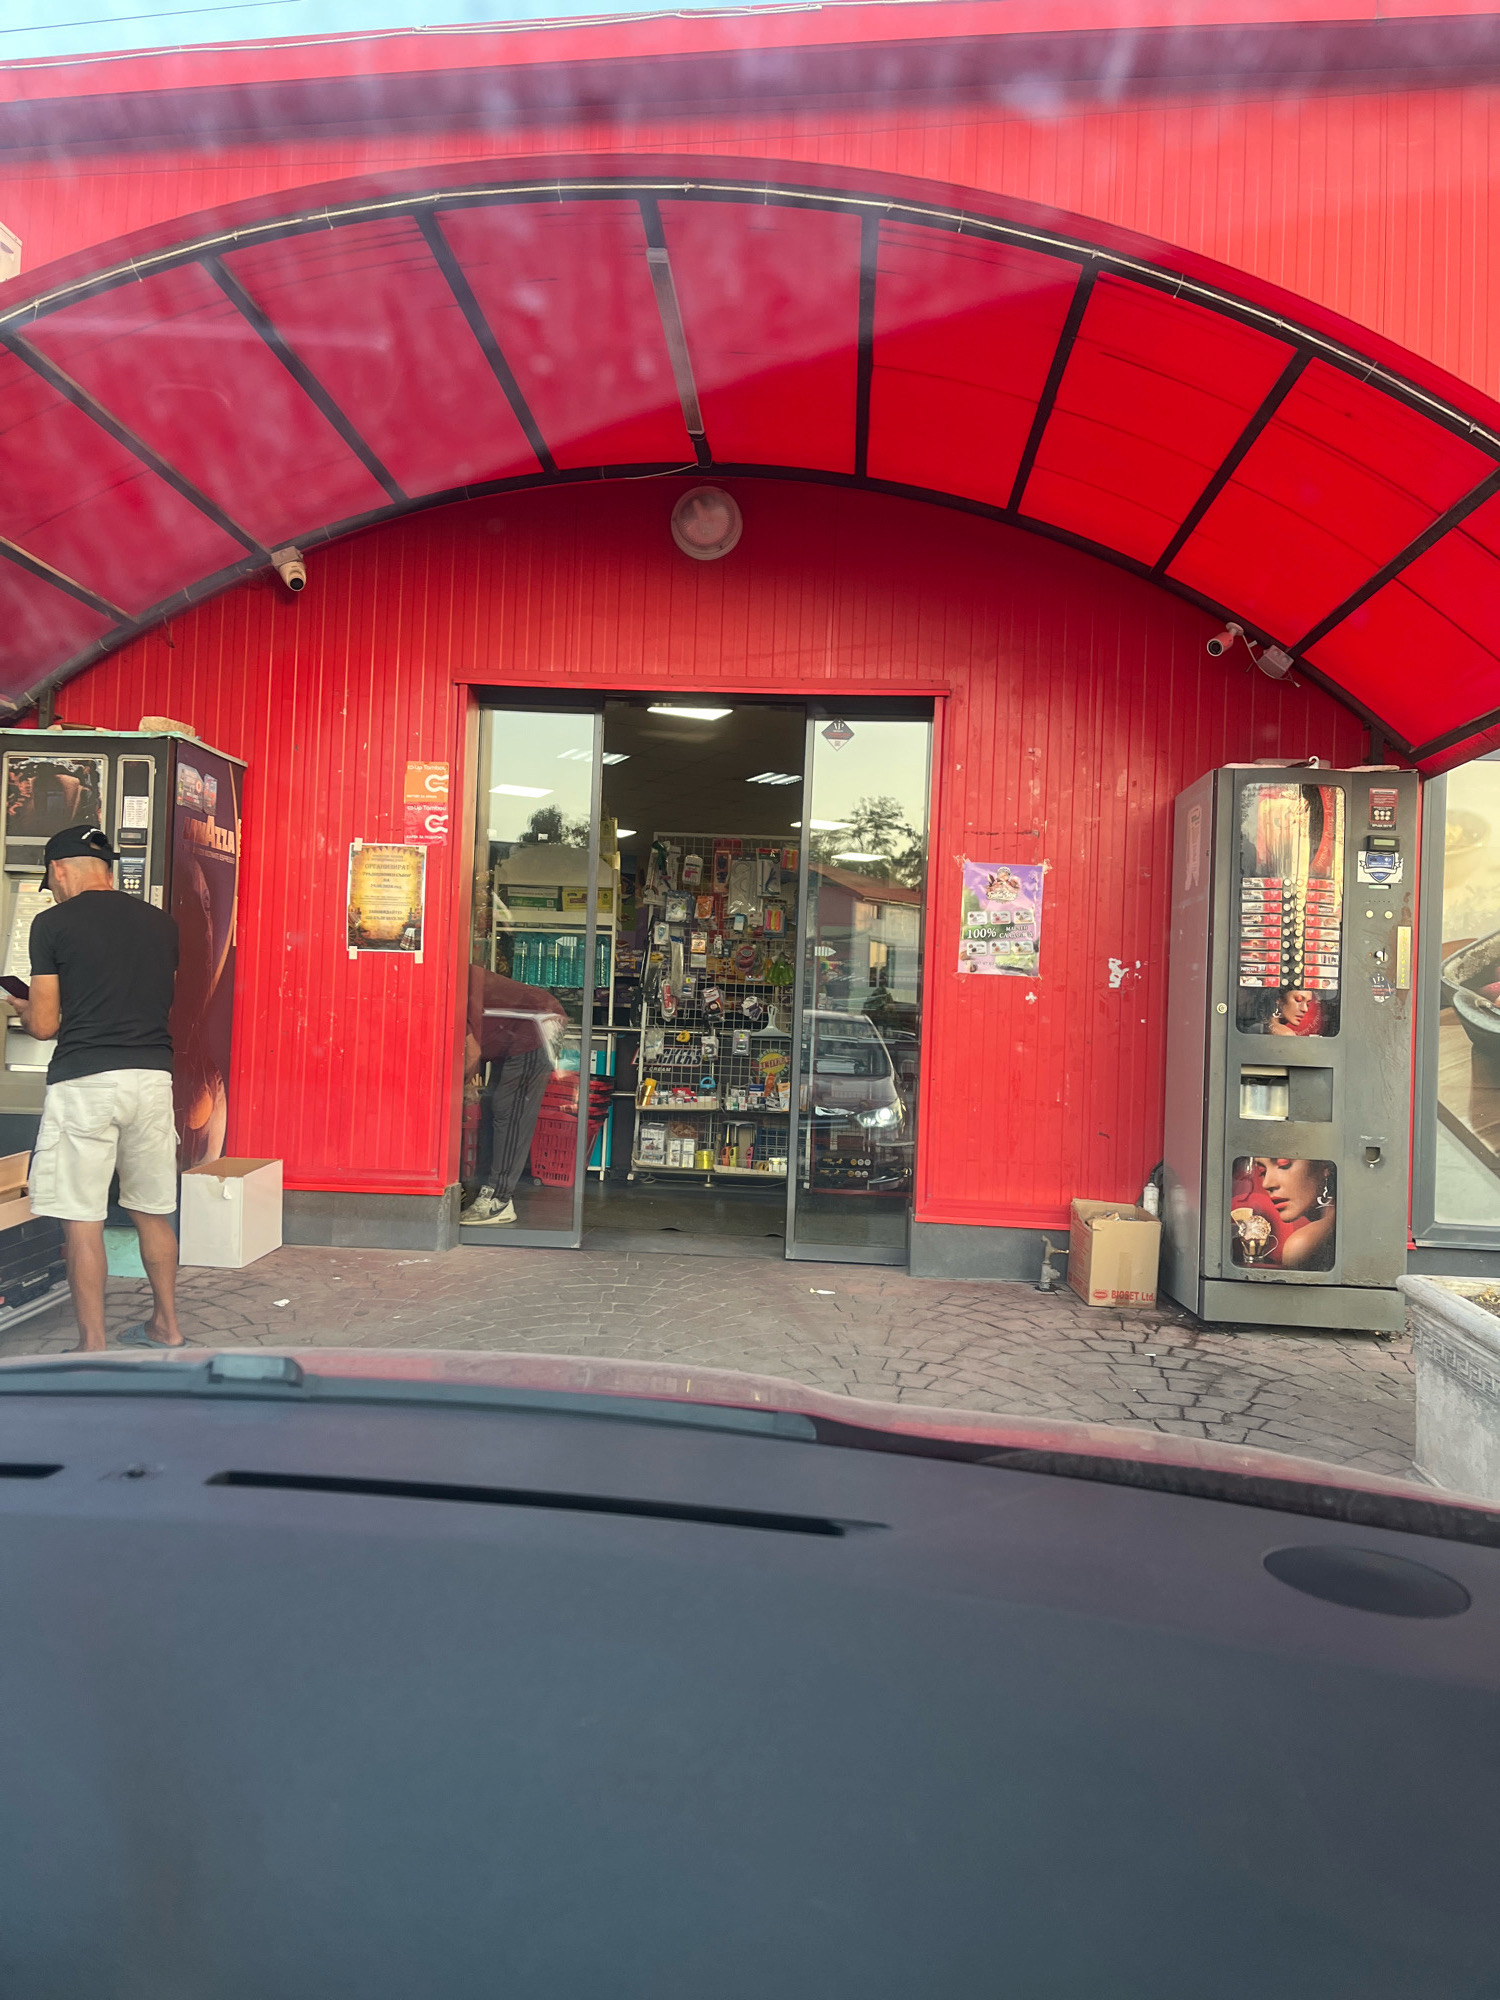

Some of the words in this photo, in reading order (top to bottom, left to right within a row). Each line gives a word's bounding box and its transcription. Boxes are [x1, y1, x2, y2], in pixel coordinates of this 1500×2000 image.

[967, 927, 996, 939] 100%
[1111, 1290, 1139, 1300] BIOSET
[1142, 1292, 1156, 1302] Ltd.
